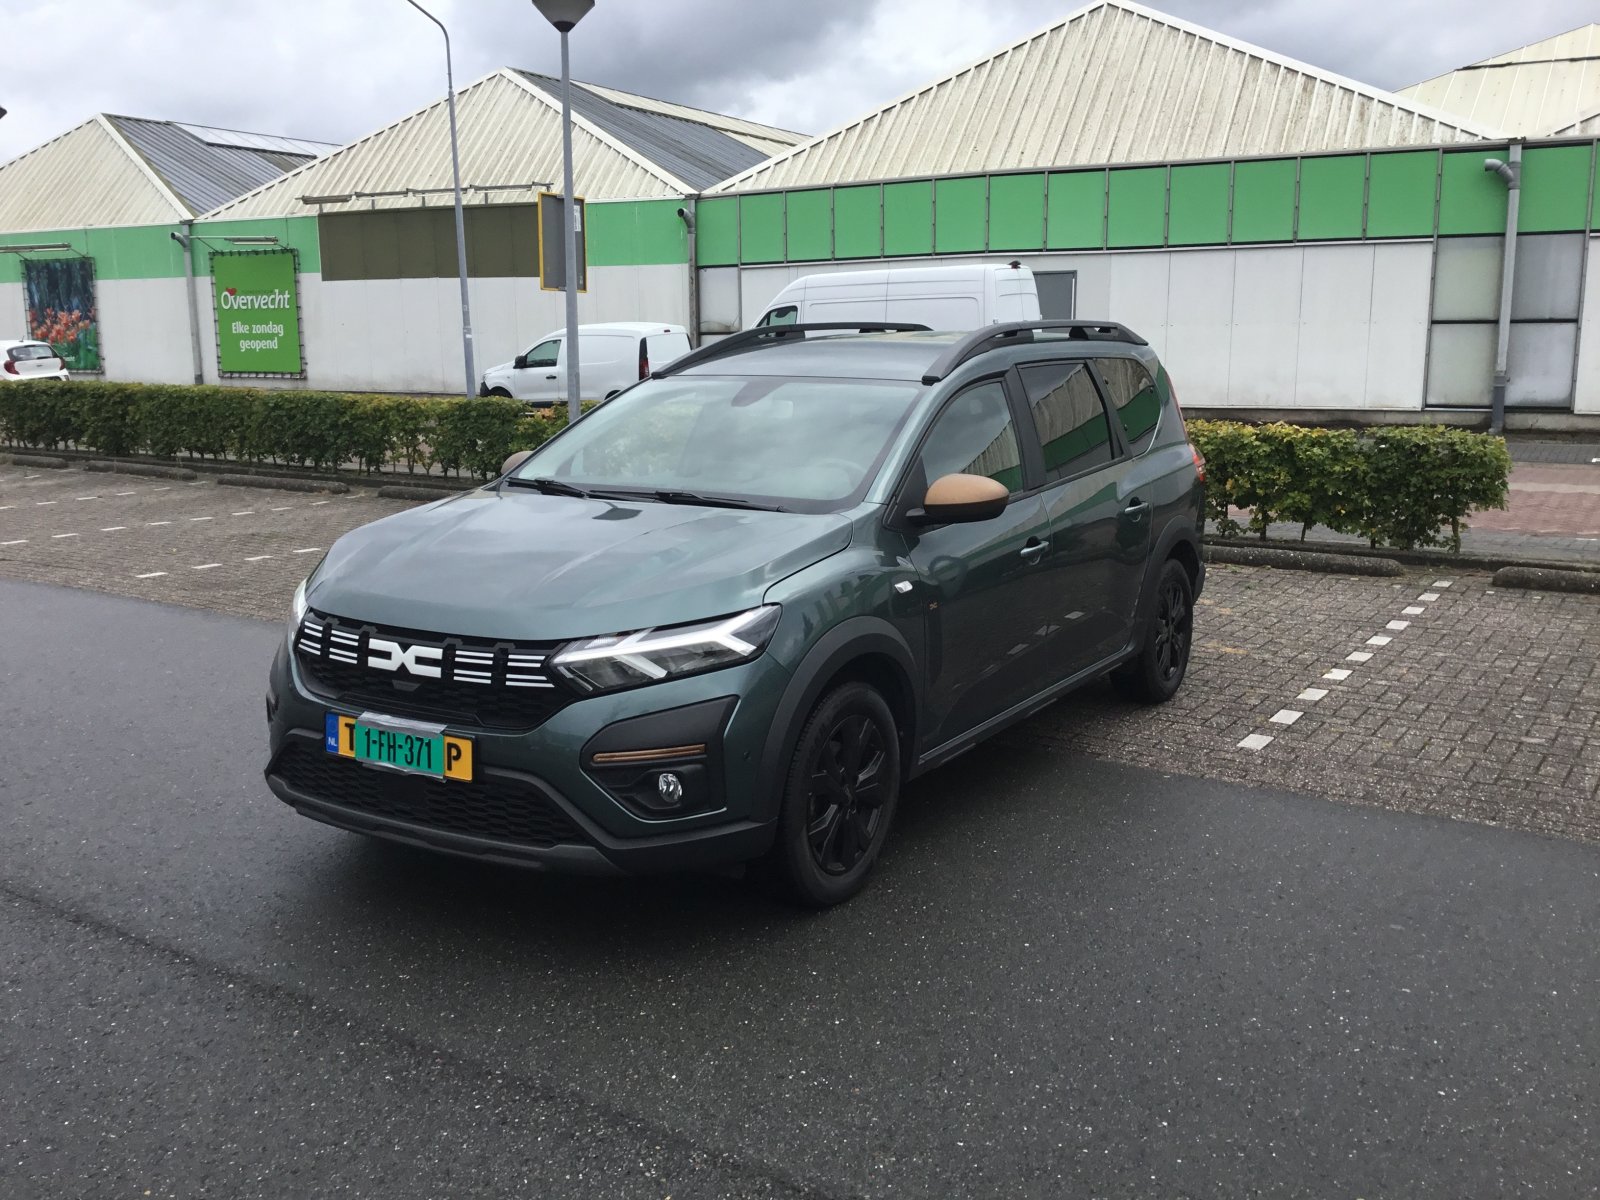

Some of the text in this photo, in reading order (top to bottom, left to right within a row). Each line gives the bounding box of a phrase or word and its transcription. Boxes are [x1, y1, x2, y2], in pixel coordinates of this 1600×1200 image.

[221, 289, 290, 309] Overvecht
[232, 321, 284, 336] Elke zondag
[240, 337, 278, 352] geopend
[328, 737, 337, 747] NL
[365, 728, 431, 769] 1-FH-371
[446, 742, 462, 771] P
